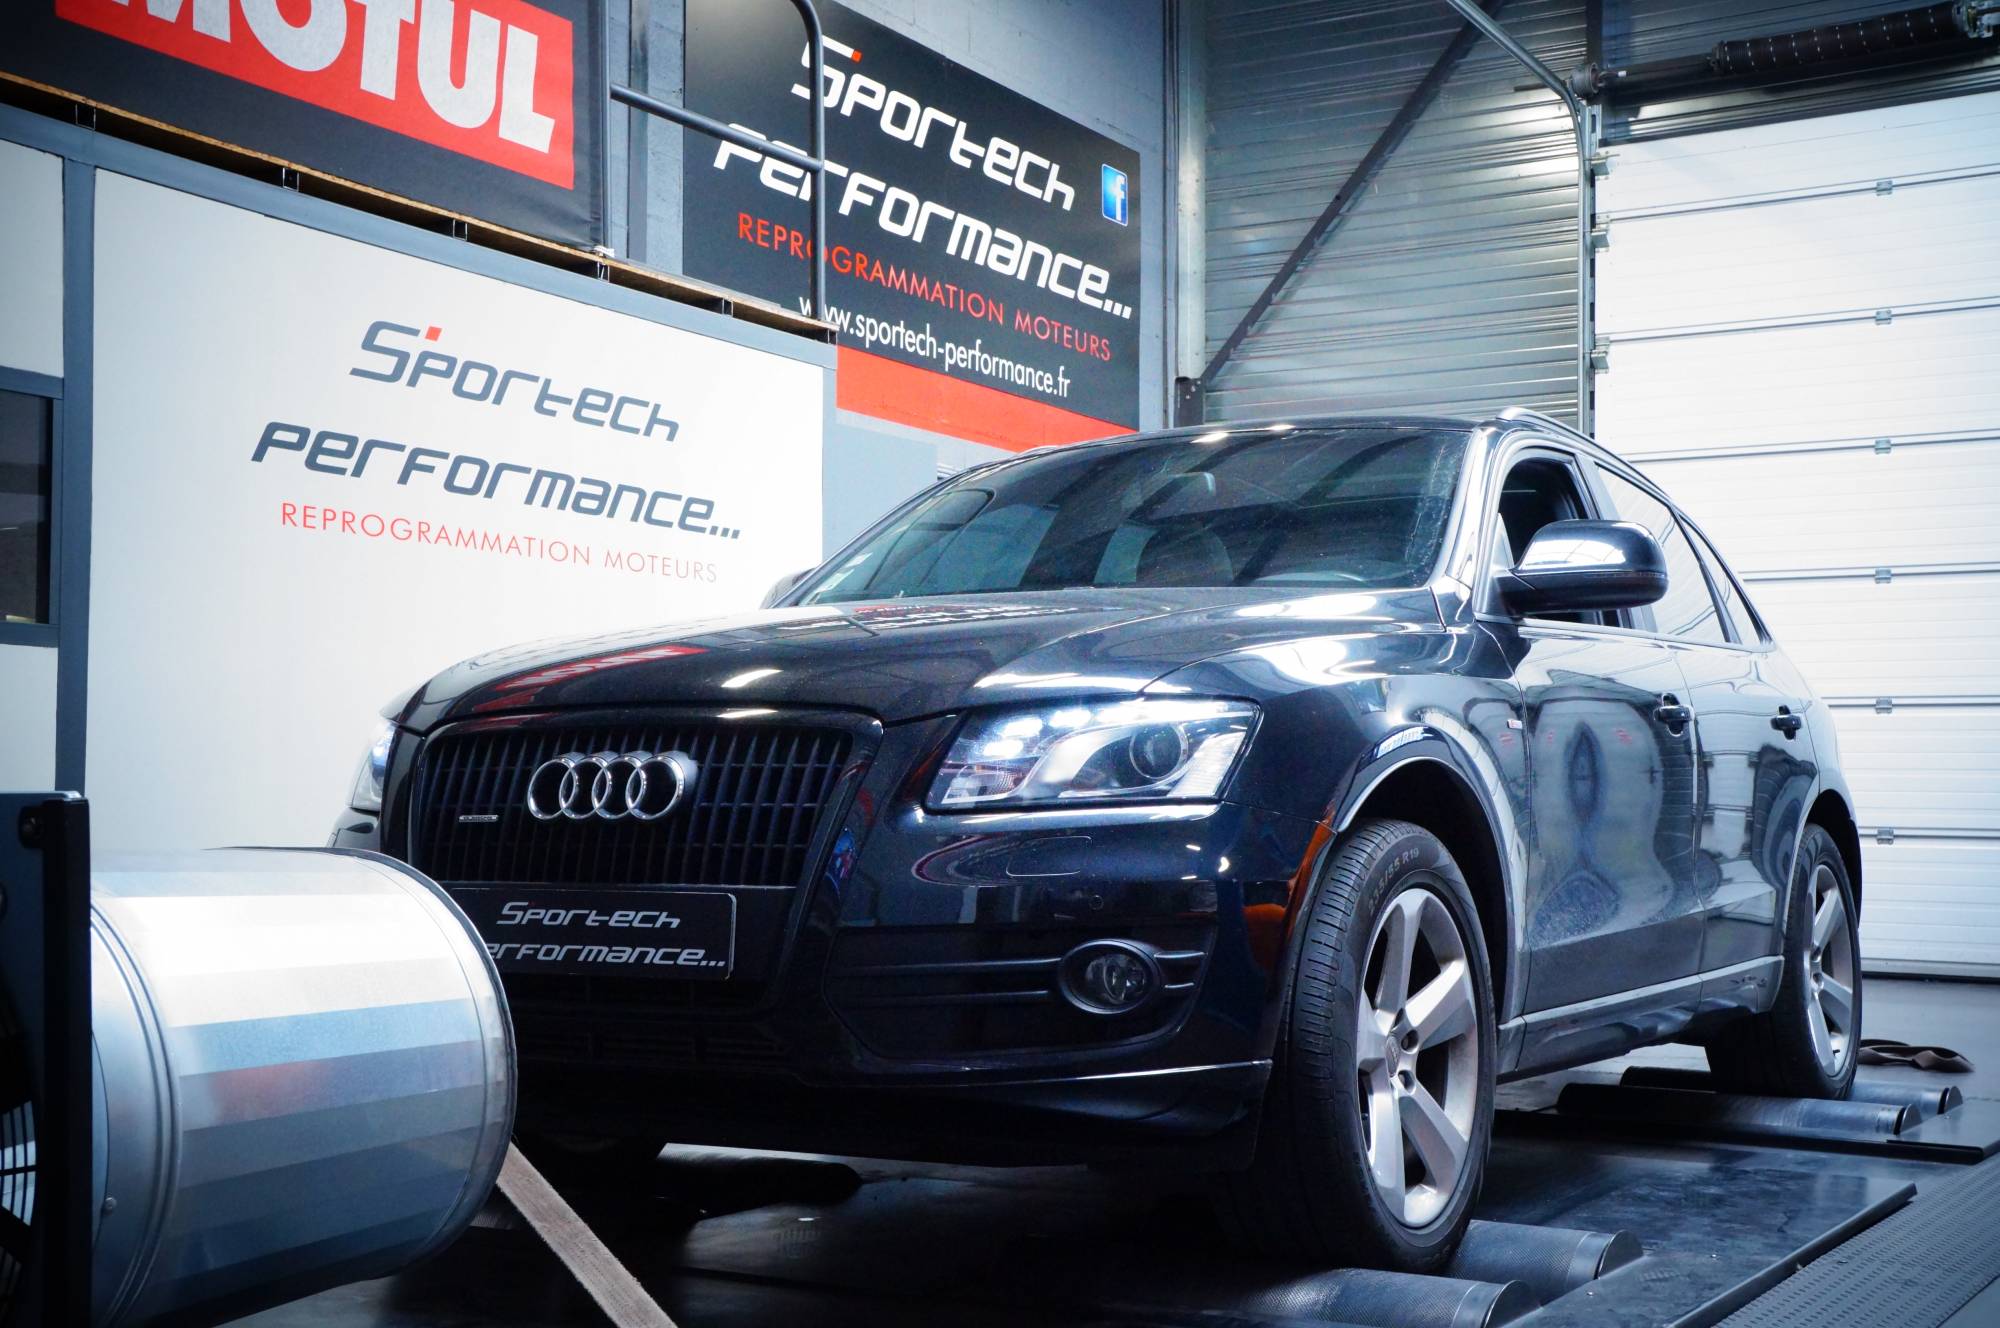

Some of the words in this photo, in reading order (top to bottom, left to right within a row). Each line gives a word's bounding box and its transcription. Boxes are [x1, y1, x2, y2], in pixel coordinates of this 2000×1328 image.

[1015, 309, 1111, 362] MOTEURS
[350, 321, 679, 442] Sportech
[281, 502, 592, 566] REPROGRAMMATION
[604, 549, 718, 584] MOTEURS
[496, 901, 680, 929] Sportech
[486, 943, 726, 967] erformance...
